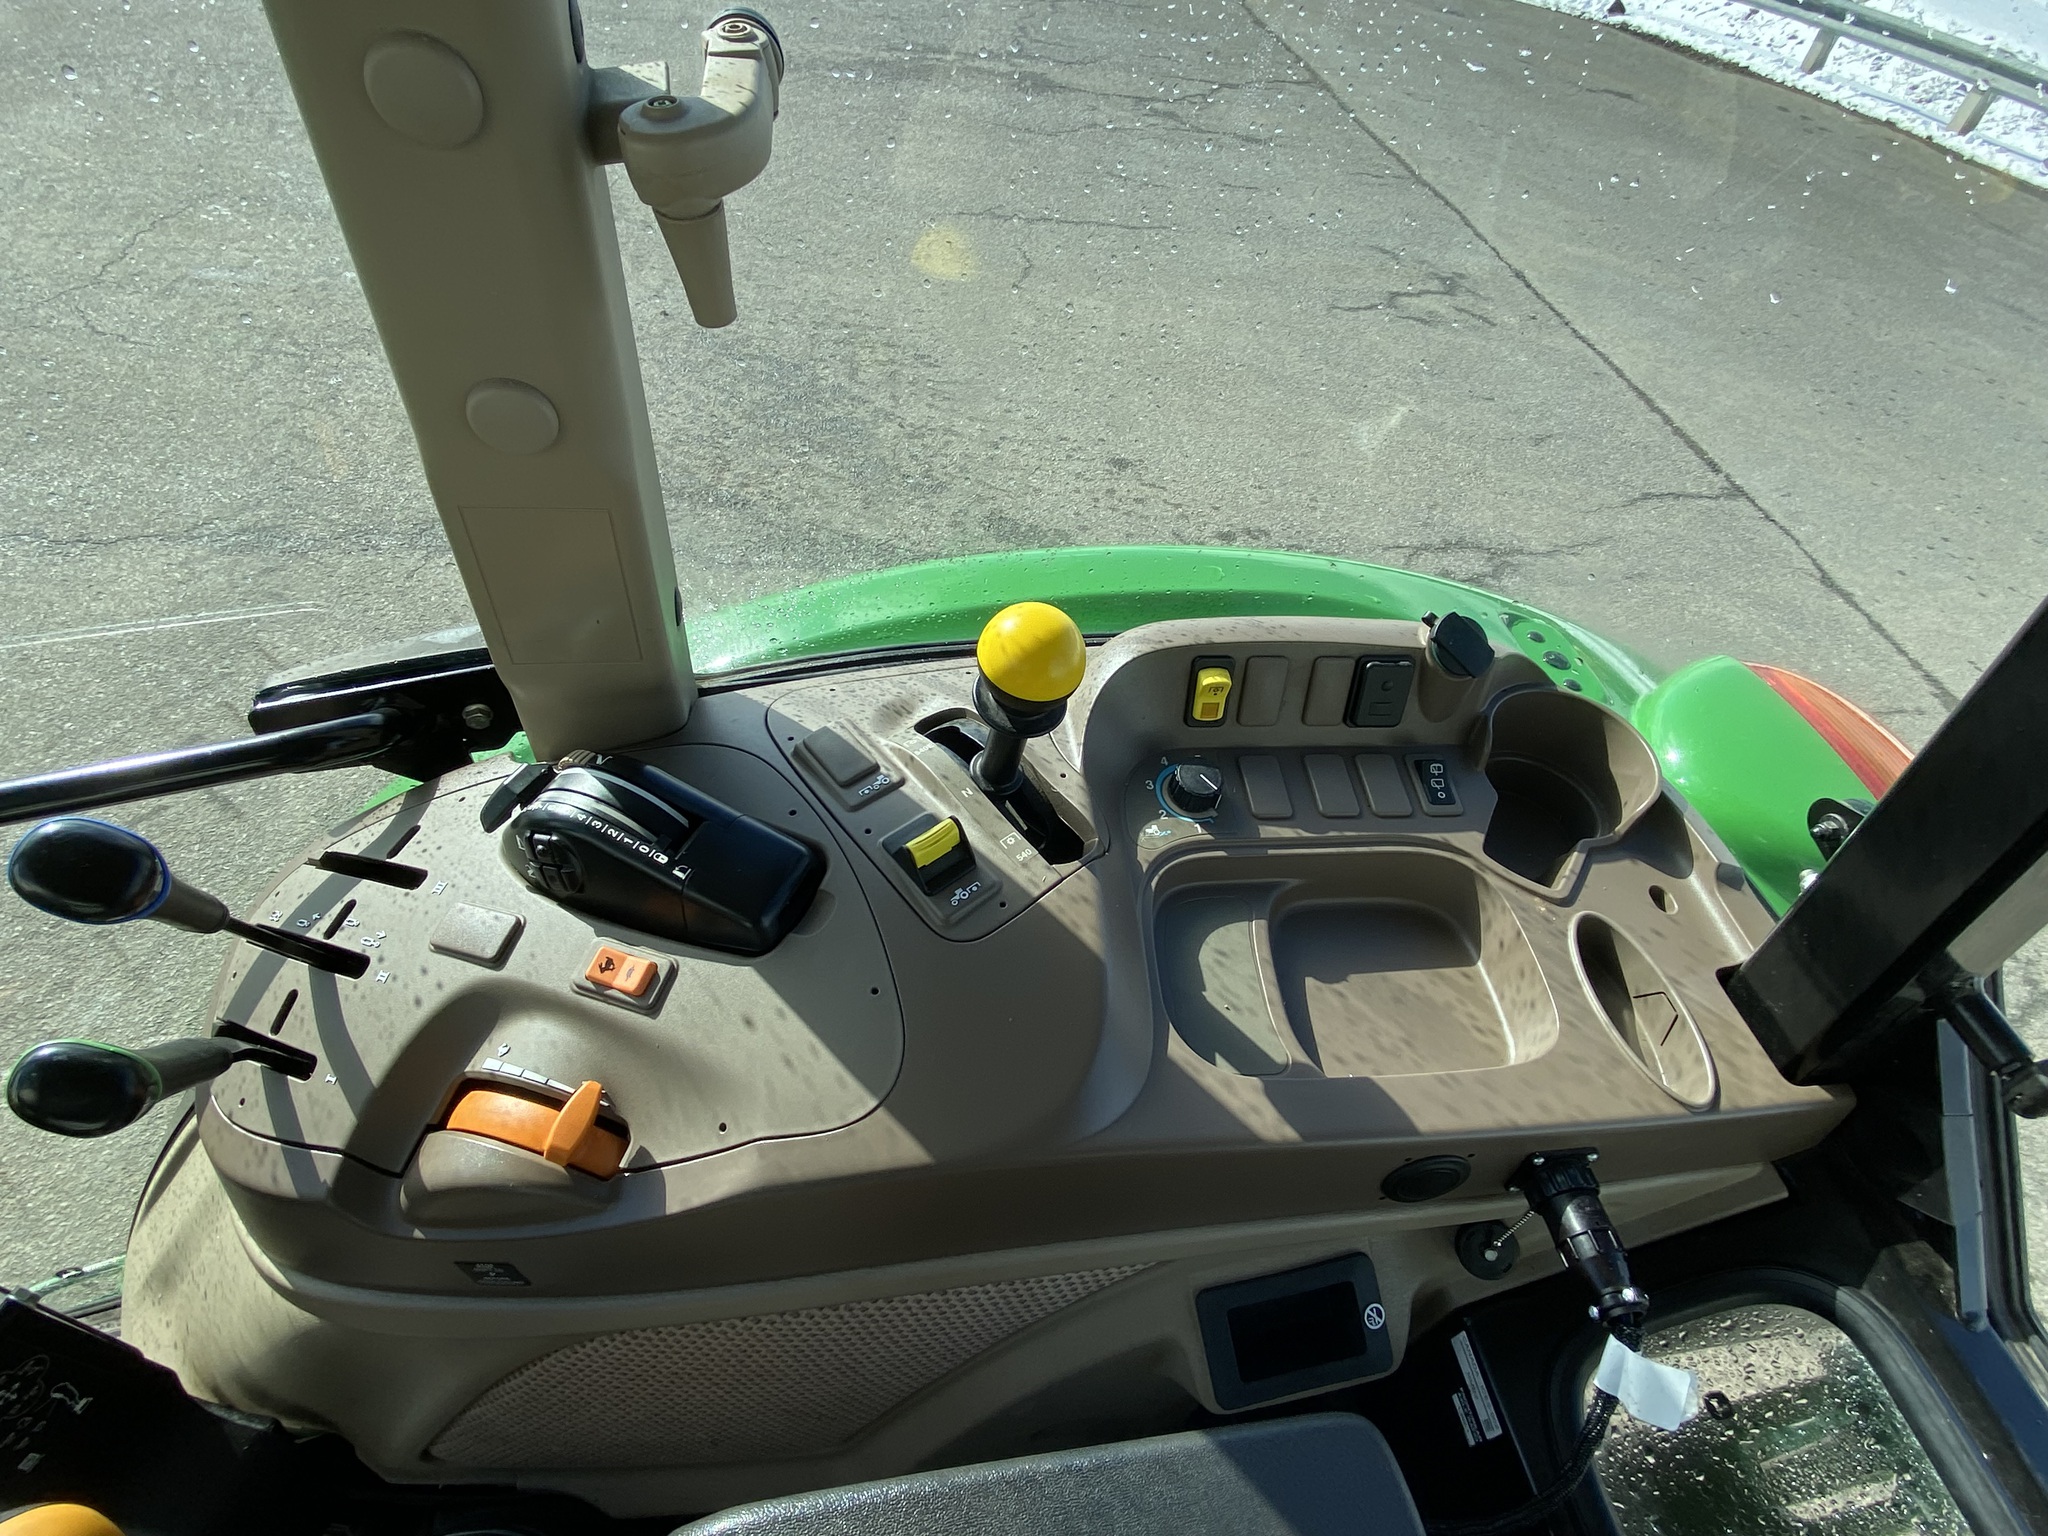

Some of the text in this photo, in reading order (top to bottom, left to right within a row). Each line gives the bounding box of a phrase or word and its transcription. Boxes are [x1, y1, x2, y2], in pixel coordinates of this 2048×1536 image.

[1160, 756, 1169, 766] 4
[1145, 780, 1154, 790] 3
[961, 787, 974, 798] N
[1158, 809, 1169, 820] 2
[576, 813, 587, 821] 4
[591, 820, 602, 829] 3
[607, 828, 619, 837] 2
[638, 844, 650, 854] 0
[1194, 823, 1202, 833] 1
[1015, 848, 1032, 862] 540
